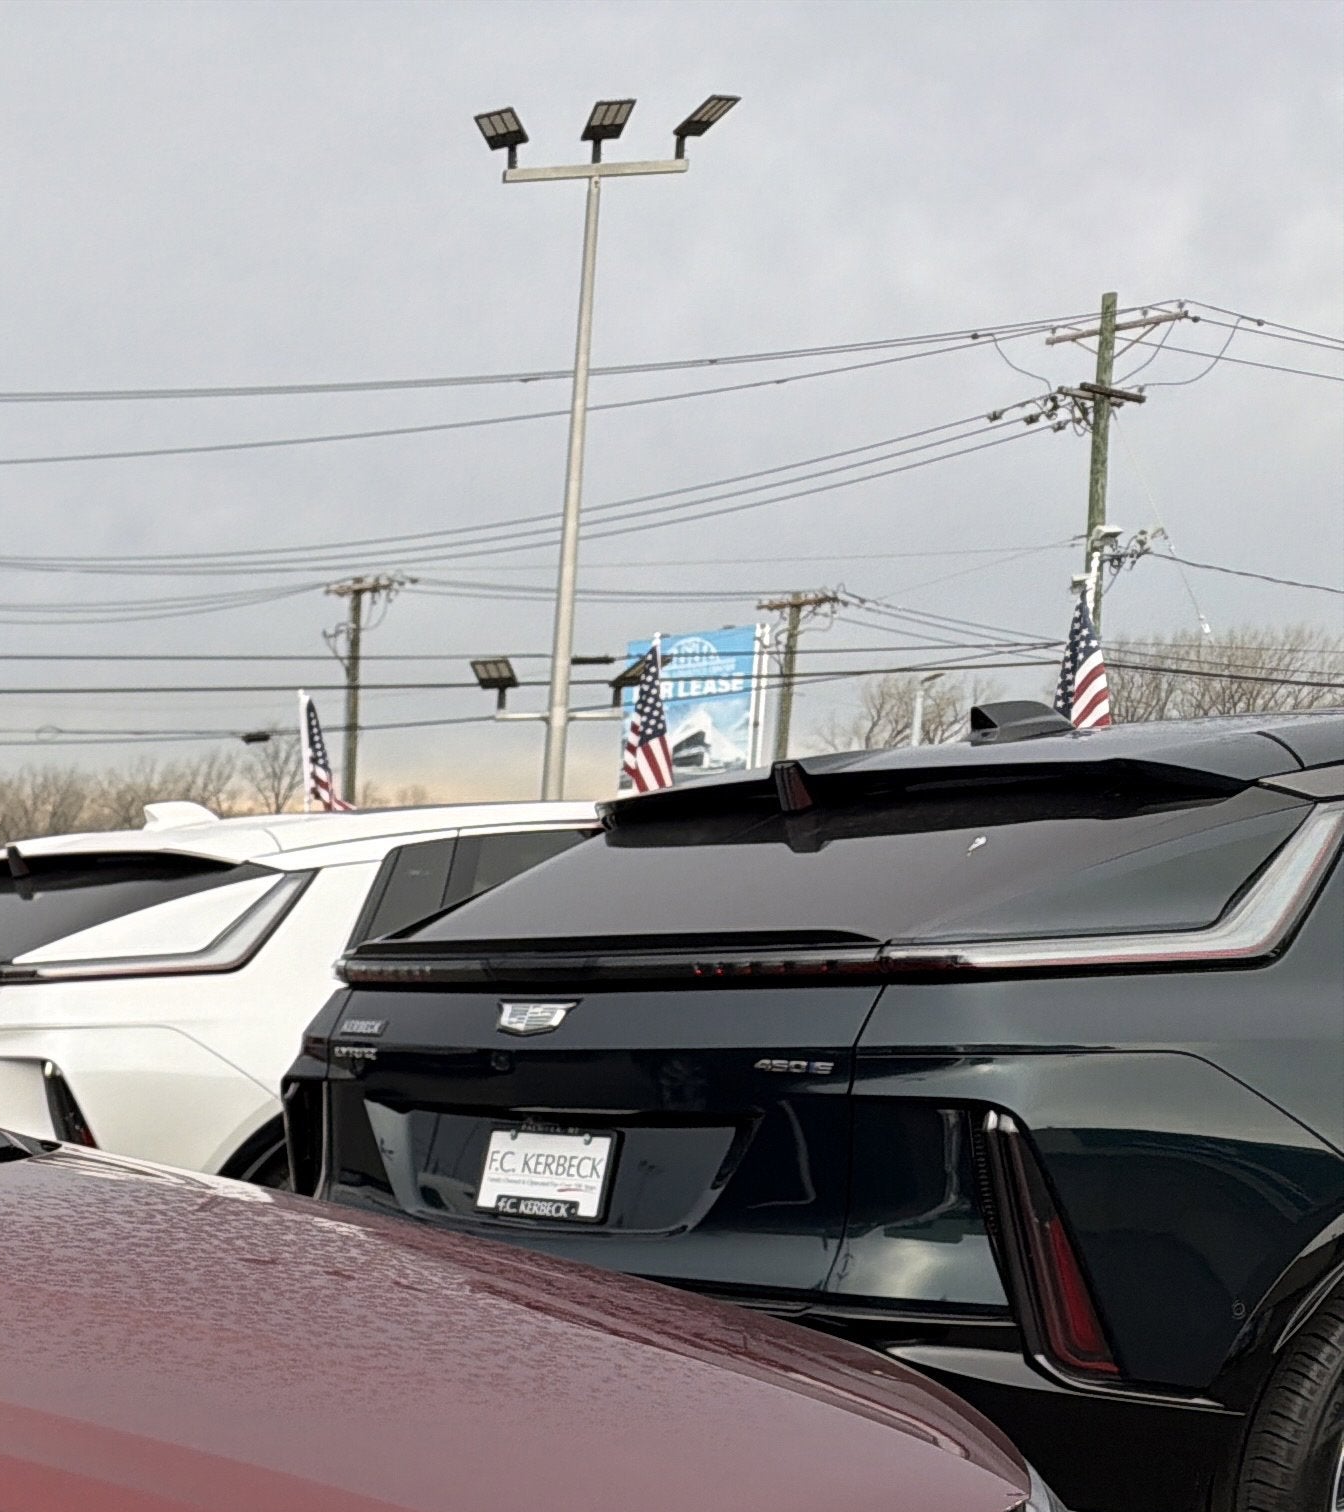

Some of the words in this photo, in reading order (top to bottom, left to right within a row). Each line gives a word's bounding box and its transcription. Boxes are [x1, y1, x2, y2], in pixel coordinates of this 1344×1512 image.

[677, 672, 745, 699] LEASE
[488, 1150, 516, 1173] F.C.
[521, 1152, 603, 1180] KERBECK
[518, 1199, 570, 1218] KERBECK
